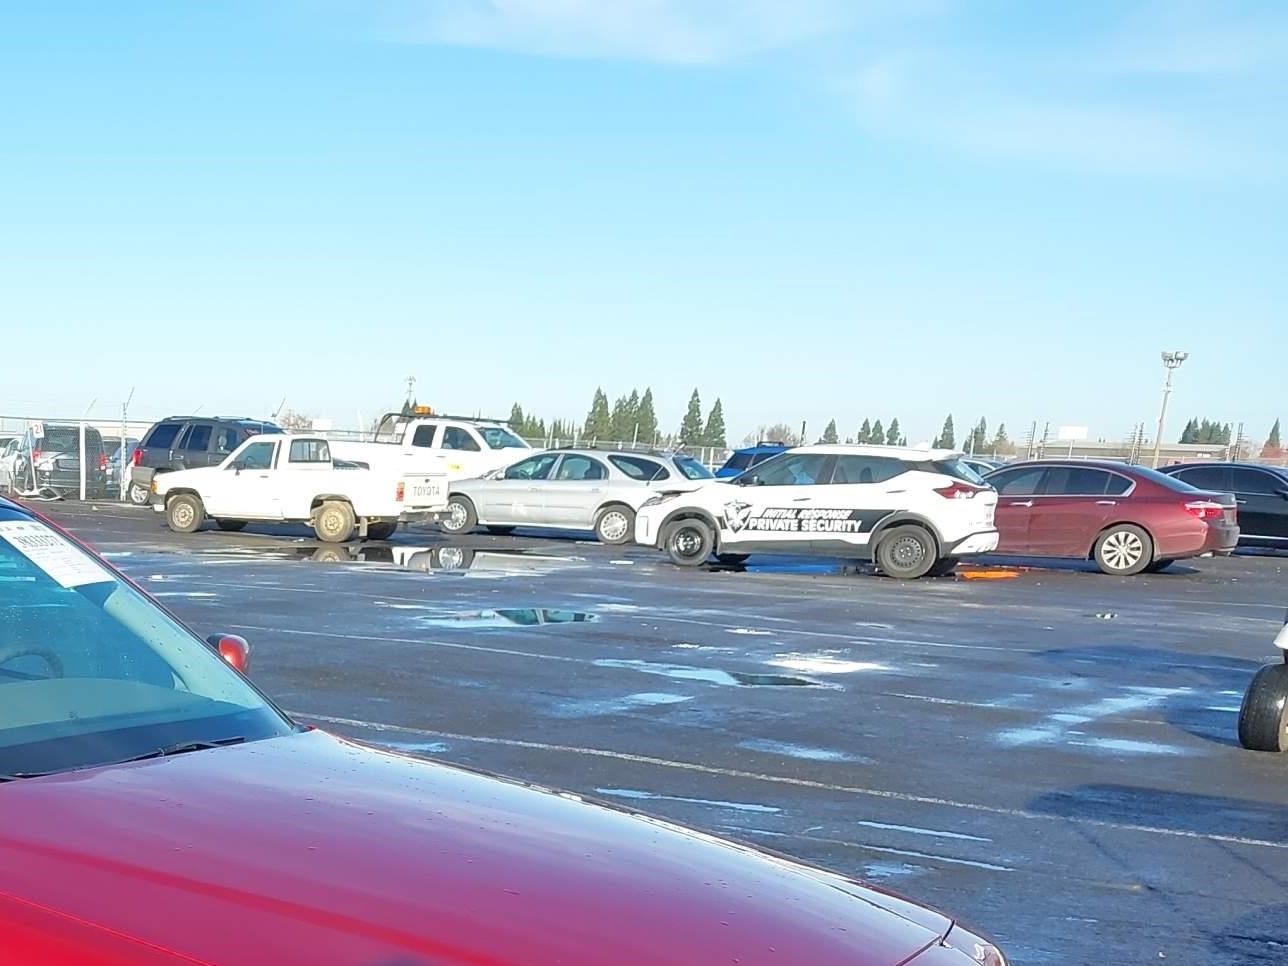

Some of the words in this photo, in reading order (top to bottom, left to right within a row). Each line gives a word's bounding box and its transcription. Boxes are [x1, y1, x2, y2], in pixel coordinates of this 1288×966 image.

[413, 486, 440, 497] TOYOTA
[762, 509, 797, 519] INITIAL
[798, 510, 852, 520] RESPONSE
[749, 518, 798, 531] PRIVATE
[801, 519, 862, 532] SECURITY
